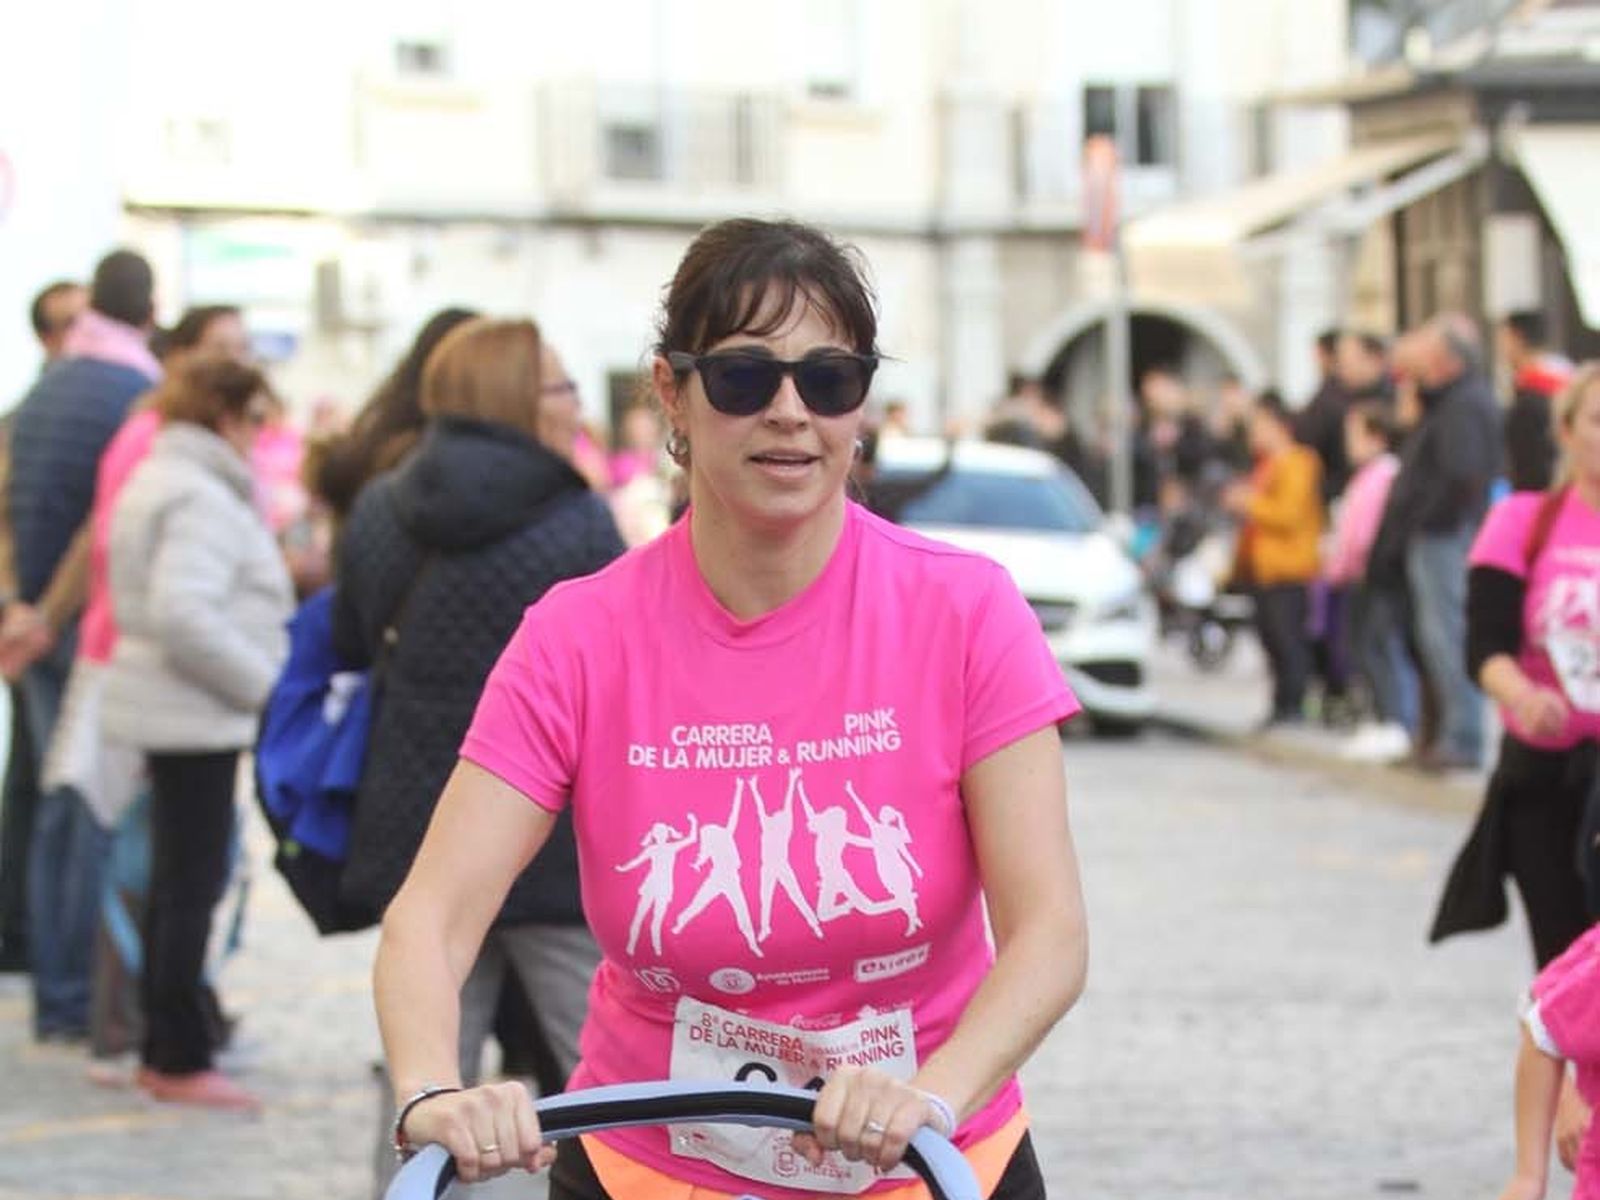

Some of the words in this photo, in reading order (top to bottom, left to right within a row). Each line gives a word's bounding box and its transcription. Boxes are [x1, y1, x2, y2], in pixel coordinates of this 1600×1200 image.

[671, 723, 773, 747] CARRERA
[844, 708, 897, 735] PINK
[628, 745, 658, 768] DE
[663, 747, 689, 769] LA
[695, 746, 773, 769] MUJER
[777, 749, 790, 765] &
[797, 730, 902, 763] RUNNING
[690, 1025, 713, 1043] DE
[717, 1033, 739, 1050] LA
[744, 1041, 804, 1066] MUJER
[722, 1020, 804, 1052] CARRERA
[860, 1023, 902, 1045] PINK
